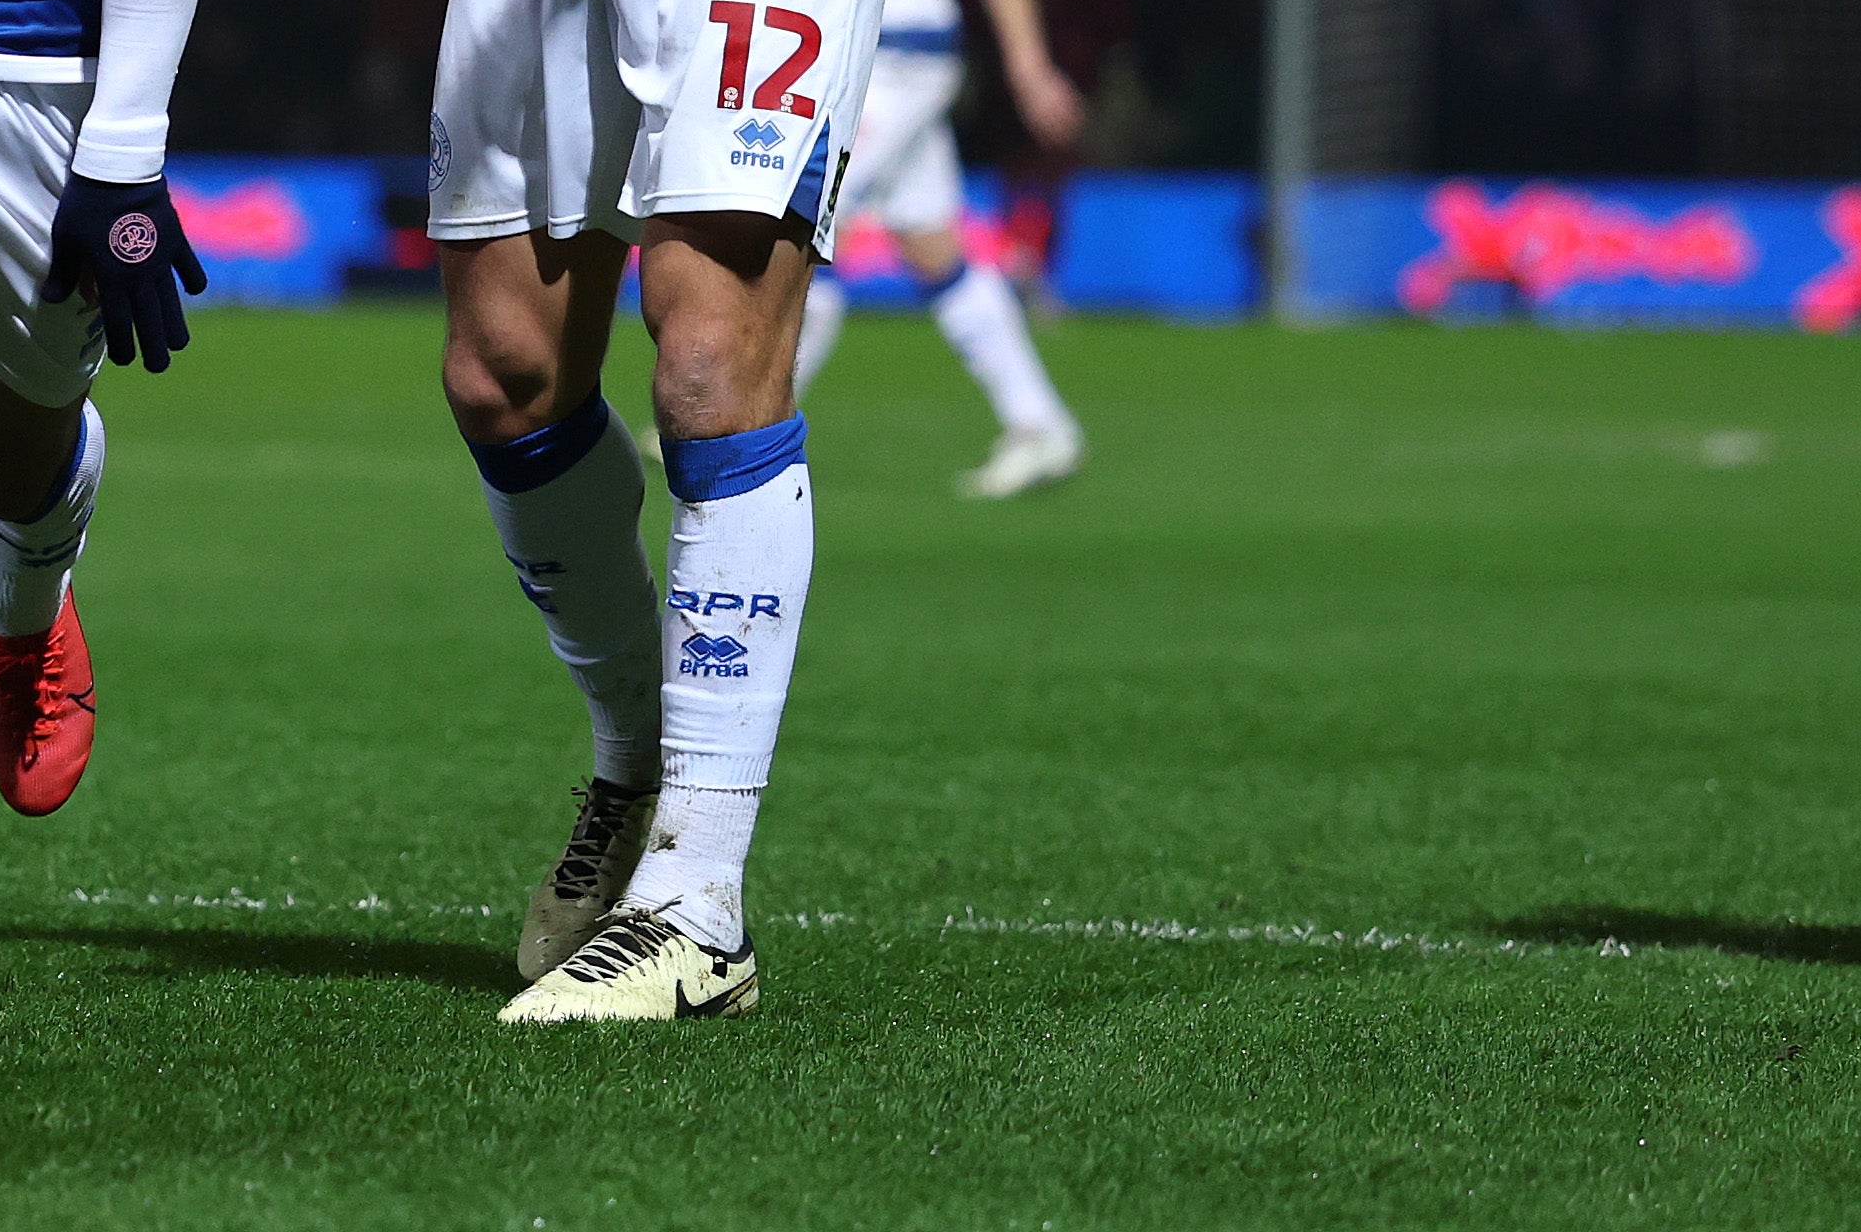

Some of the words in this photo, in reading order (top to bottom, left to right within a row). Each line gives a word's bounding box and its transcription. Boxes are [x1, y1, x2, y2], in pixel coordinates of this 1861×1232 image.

[708, 0, 822, 120] 12
[730, 150, 784, 170] errea
[667, 590, 782, 618] QPR
[679, 658, 748, 677] errea
